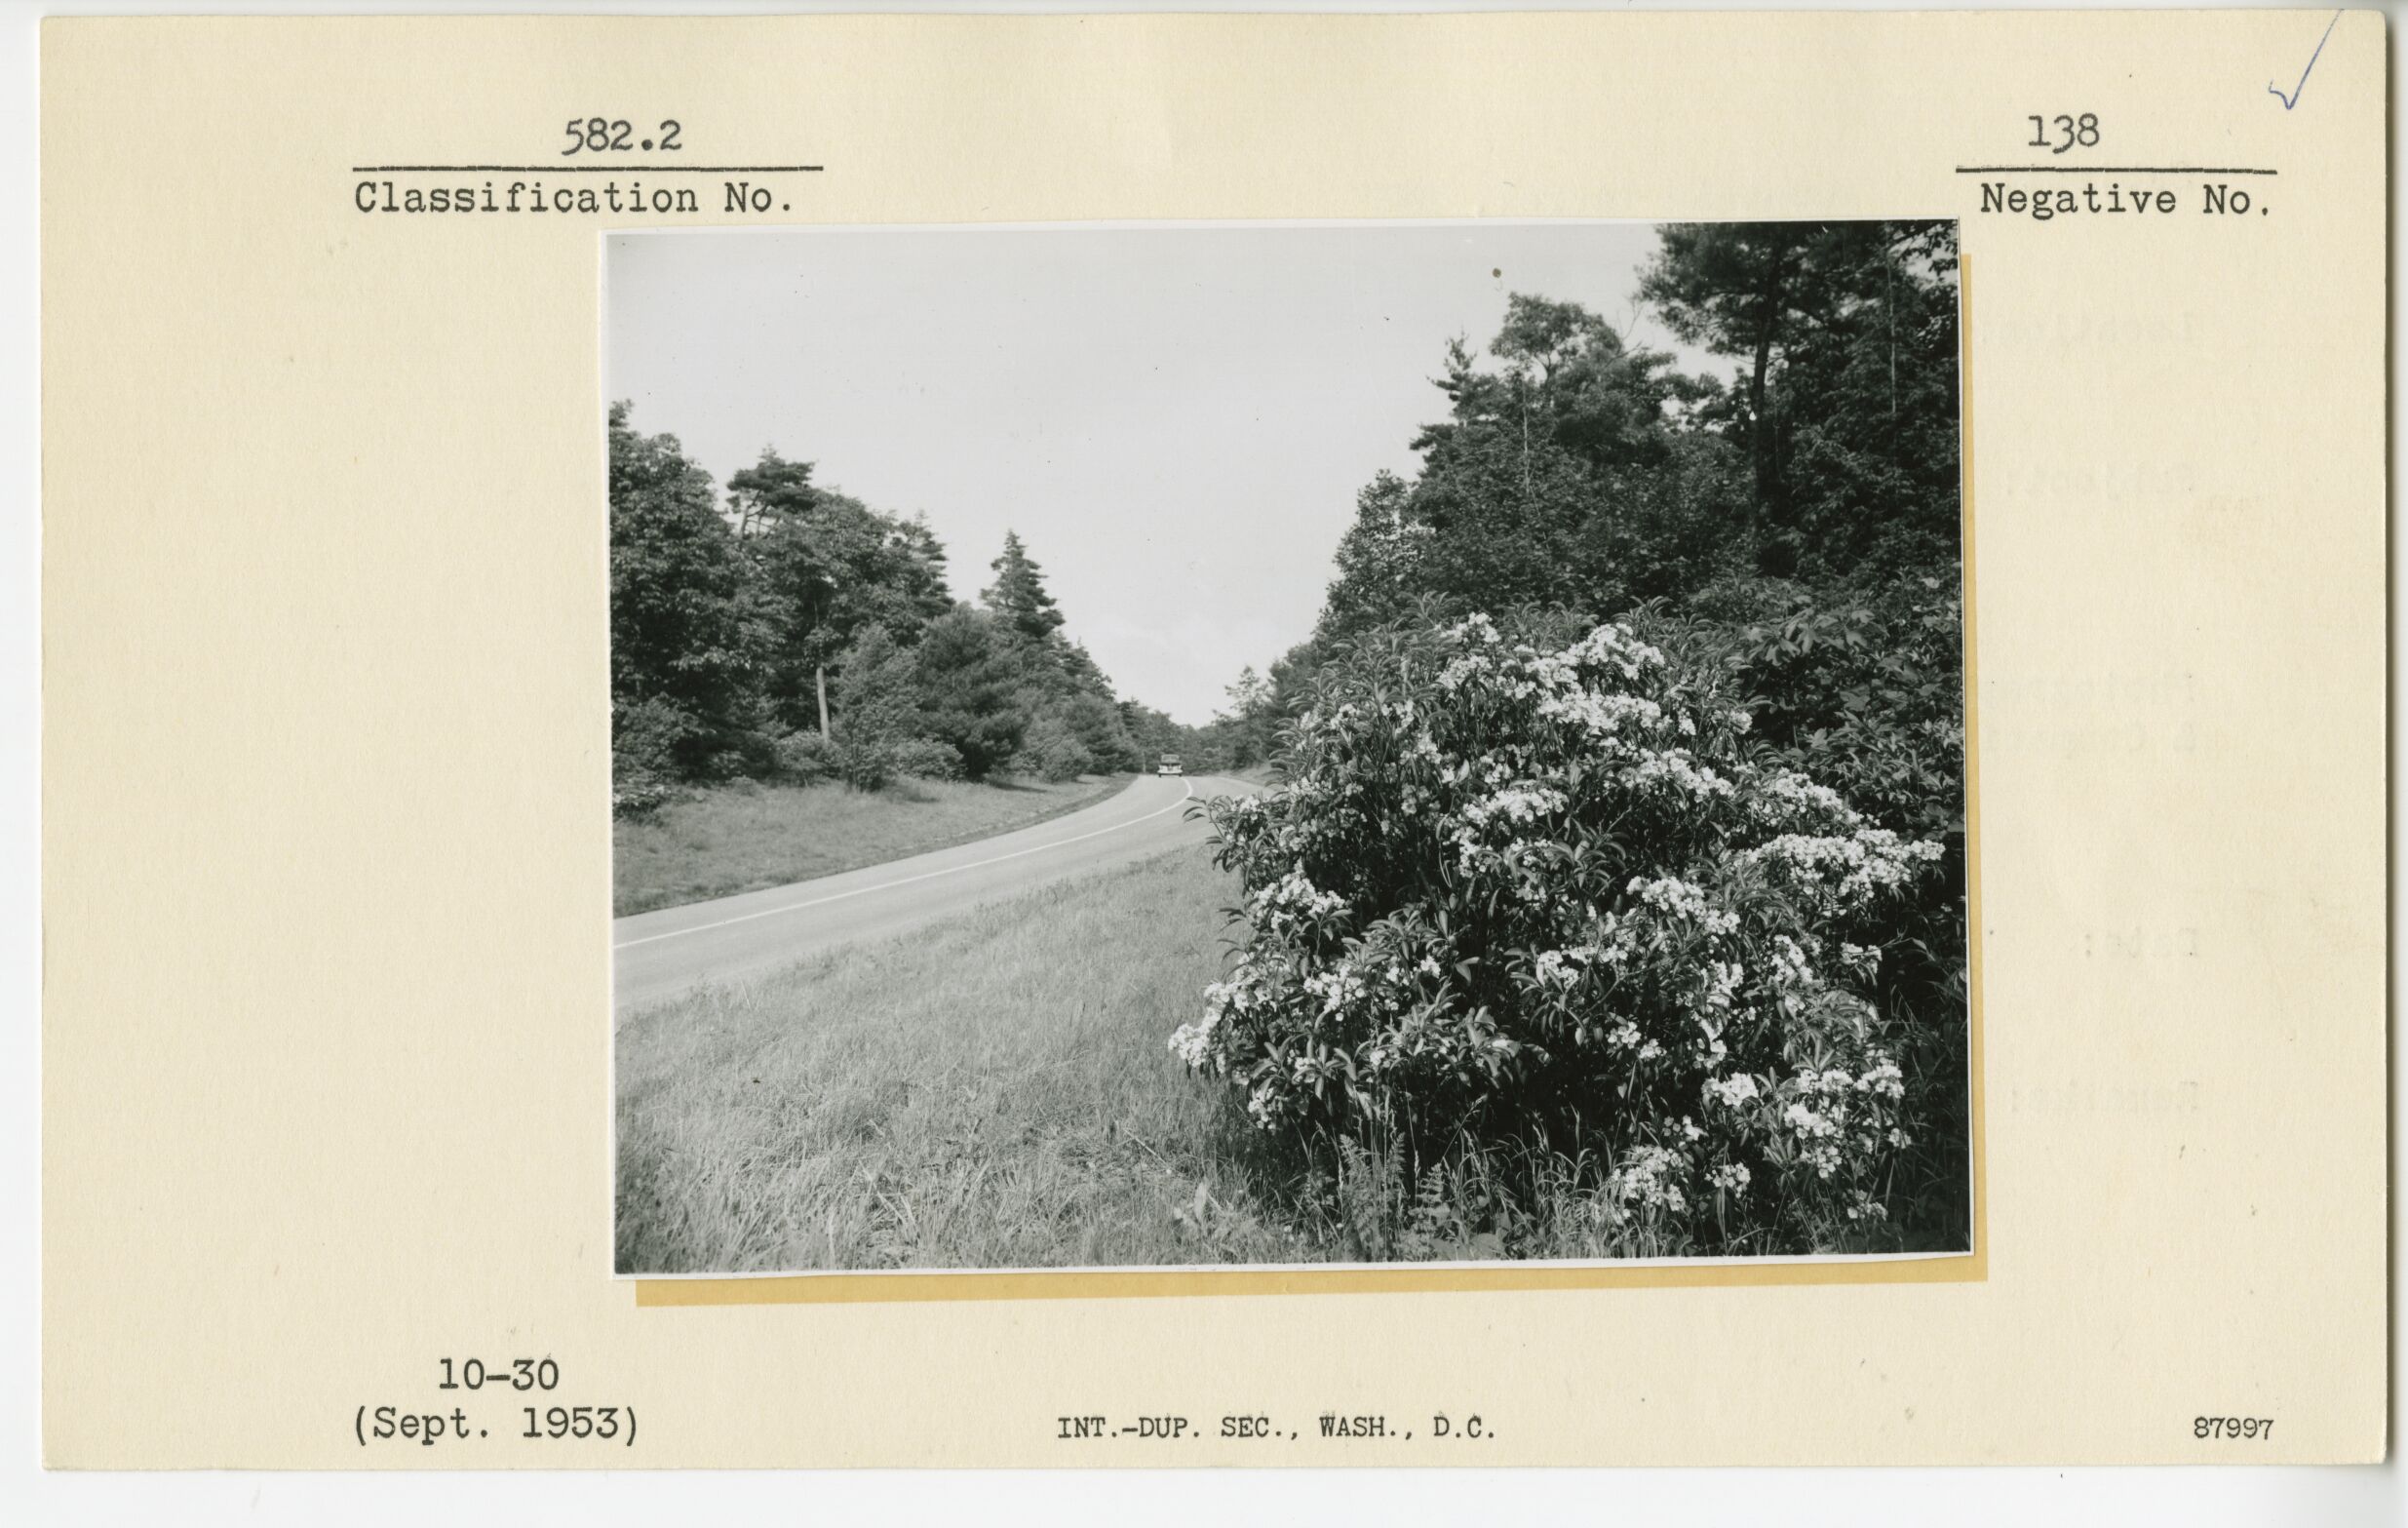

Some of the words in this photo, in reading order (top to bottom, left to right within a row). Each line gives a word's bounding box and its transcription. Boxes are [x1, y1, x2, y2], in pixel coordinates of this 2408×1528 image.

[562, 117, 682, 156] 582.2
[2028, 112, 2100, 154] 138
[355, 180, 699, 214] Classification
[724, 181, 792, 214] No.
[1980, 182, 2177, 221] Negative
[2202, 183, 2270, 216] No.
[439, 1357, 560, 1391] 10-30
[356, 1405, 488, 1447] (Sept.
[523, 1406, 637, 1447] 1953)
[1058, 1416, 1201, 1439] INT.-DUP.
[1221, 1416, 1299, 1441] SEC.,
[1318, 1415, 1414, 1441] WASH.,
[1433, 1415, 1495, 1439] D.C.
[2194, 1416, 2274, 1440] 87997
